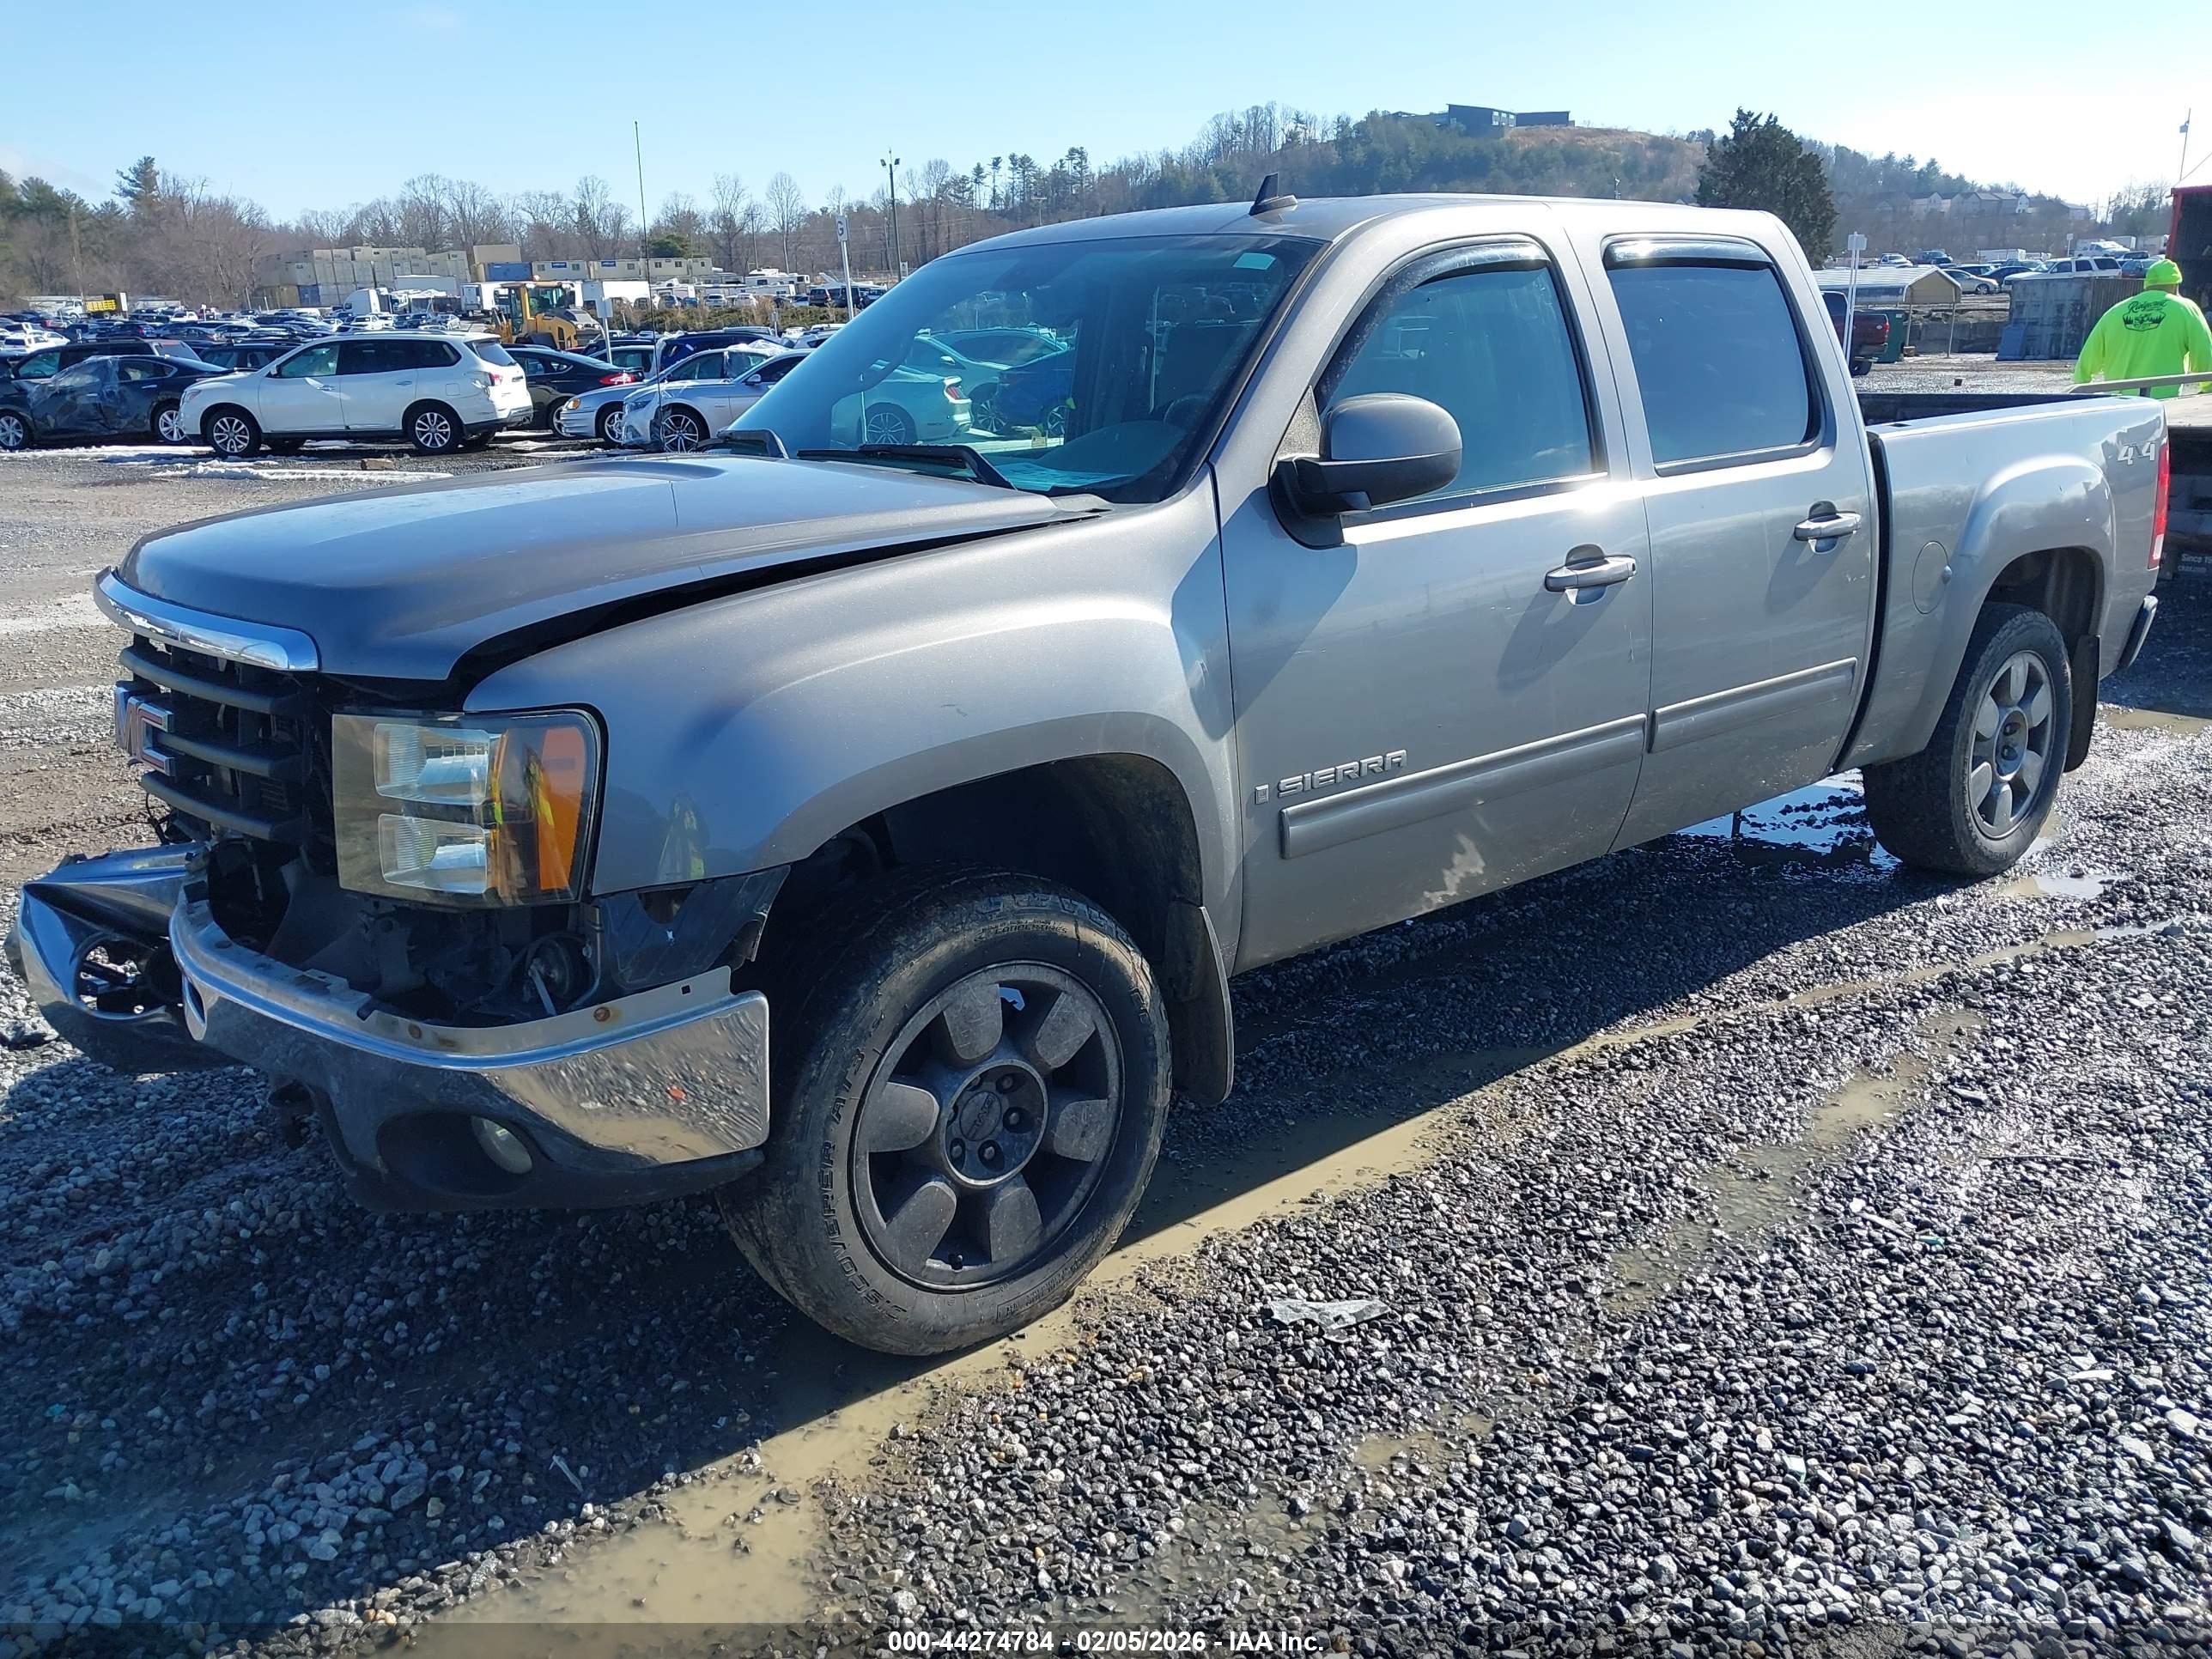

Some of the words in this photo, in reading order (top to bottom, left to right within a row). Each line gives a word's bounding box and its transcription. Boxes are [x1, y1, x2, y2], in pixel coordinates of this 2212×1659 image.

[837, 221, 844, 236] G
[1278, 749, 1408, 798] SIERRA
[818, 1140, 908, 1323] DISCOVERER
